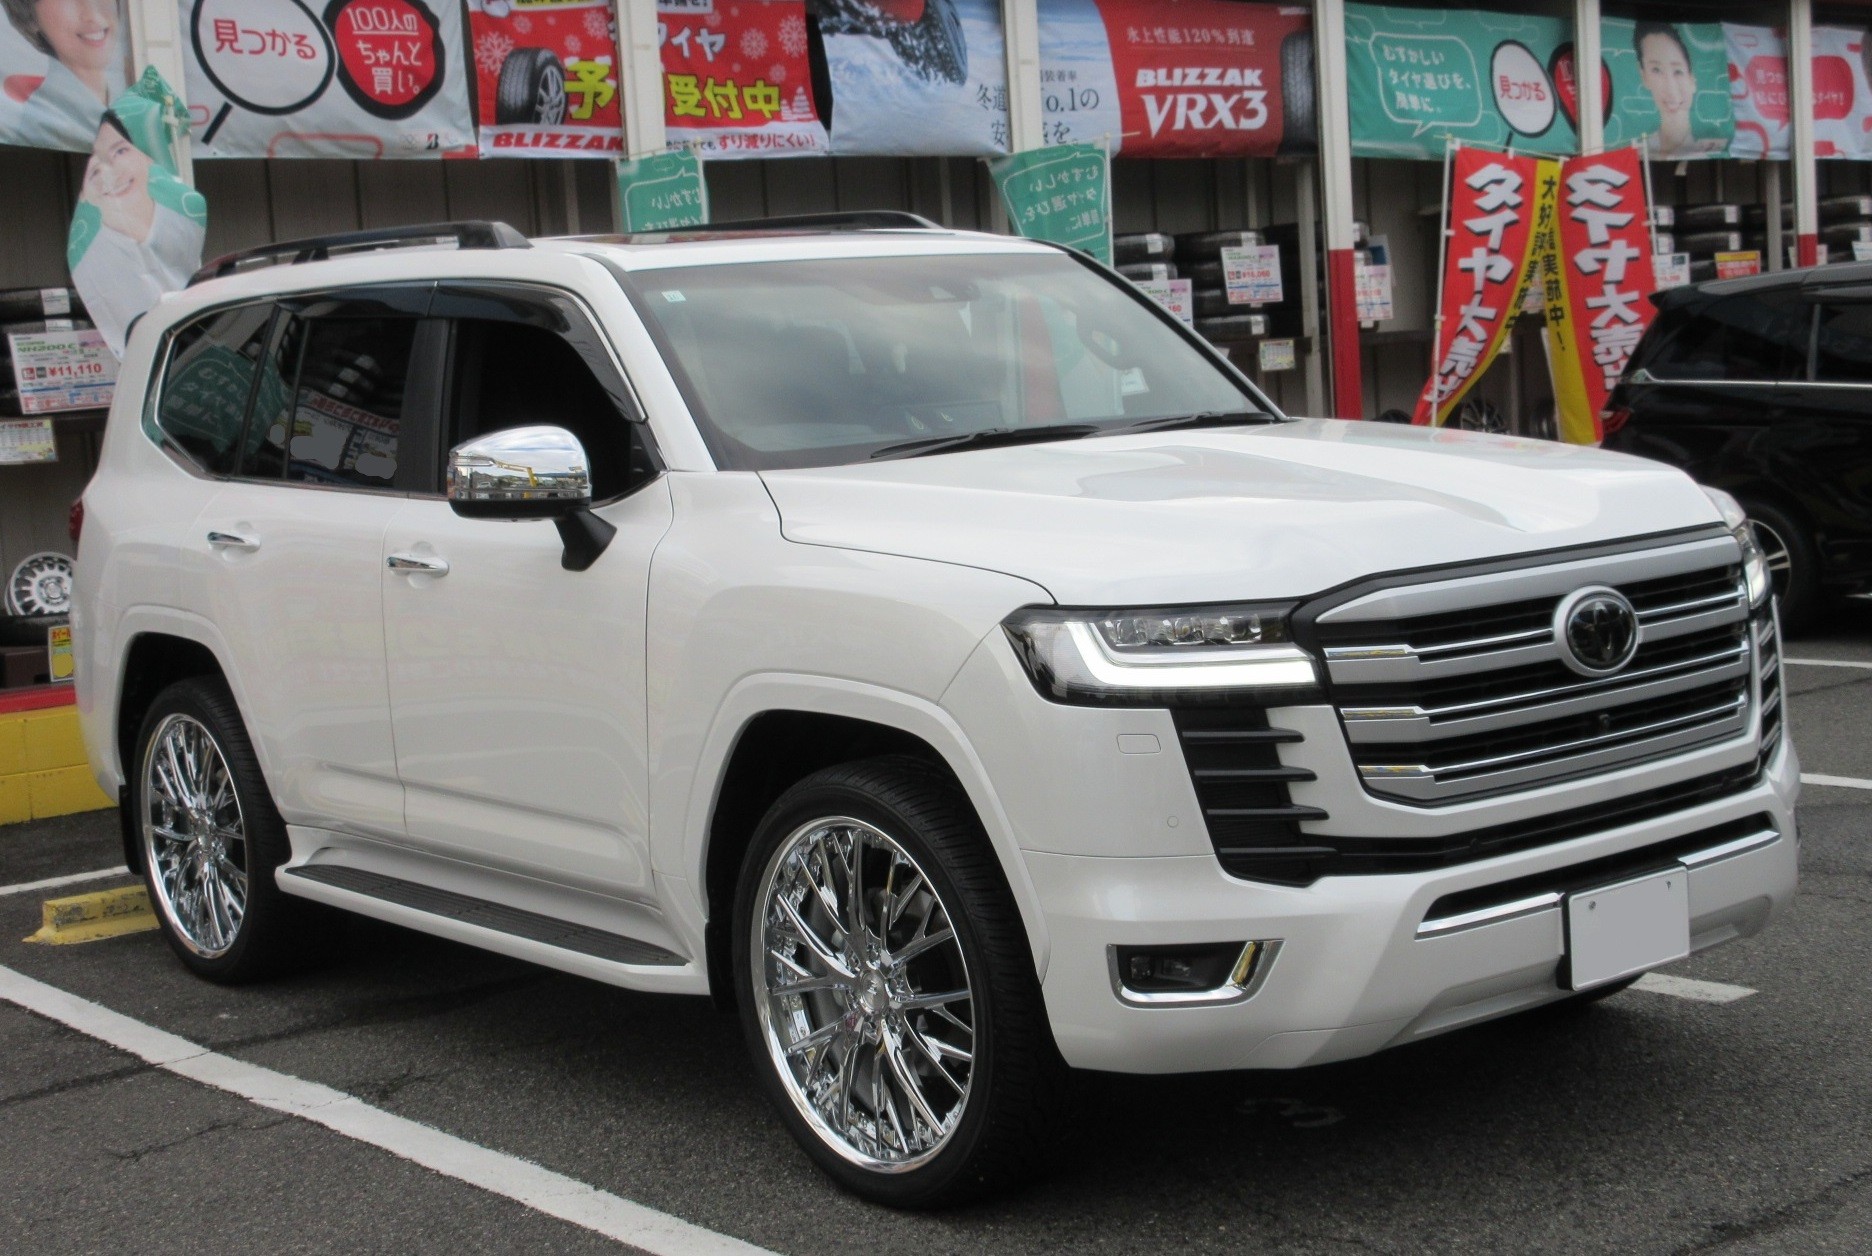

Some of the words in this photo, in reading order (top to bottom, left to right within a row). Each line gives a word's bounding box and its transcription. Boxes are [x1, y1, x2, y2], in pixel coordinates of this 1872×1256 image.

[347, 7, 418, 31] 100人の
[213, 19, 317, 60] 見つかる
[356, 40, 422, 66] ちゃんと
[371, 67, 420, 95] 買い。
[564, 57, 781, 120] 予受付中
[1135, 67, 1264, 90] BLIZZAK
[1499, 74, 1546, 102] 見つかる
[1139, 89, 1269, 139] VRX3
[493, 132, 623, 151] BLIZZAK
[49, 363, 102, 379] ¥11,110
